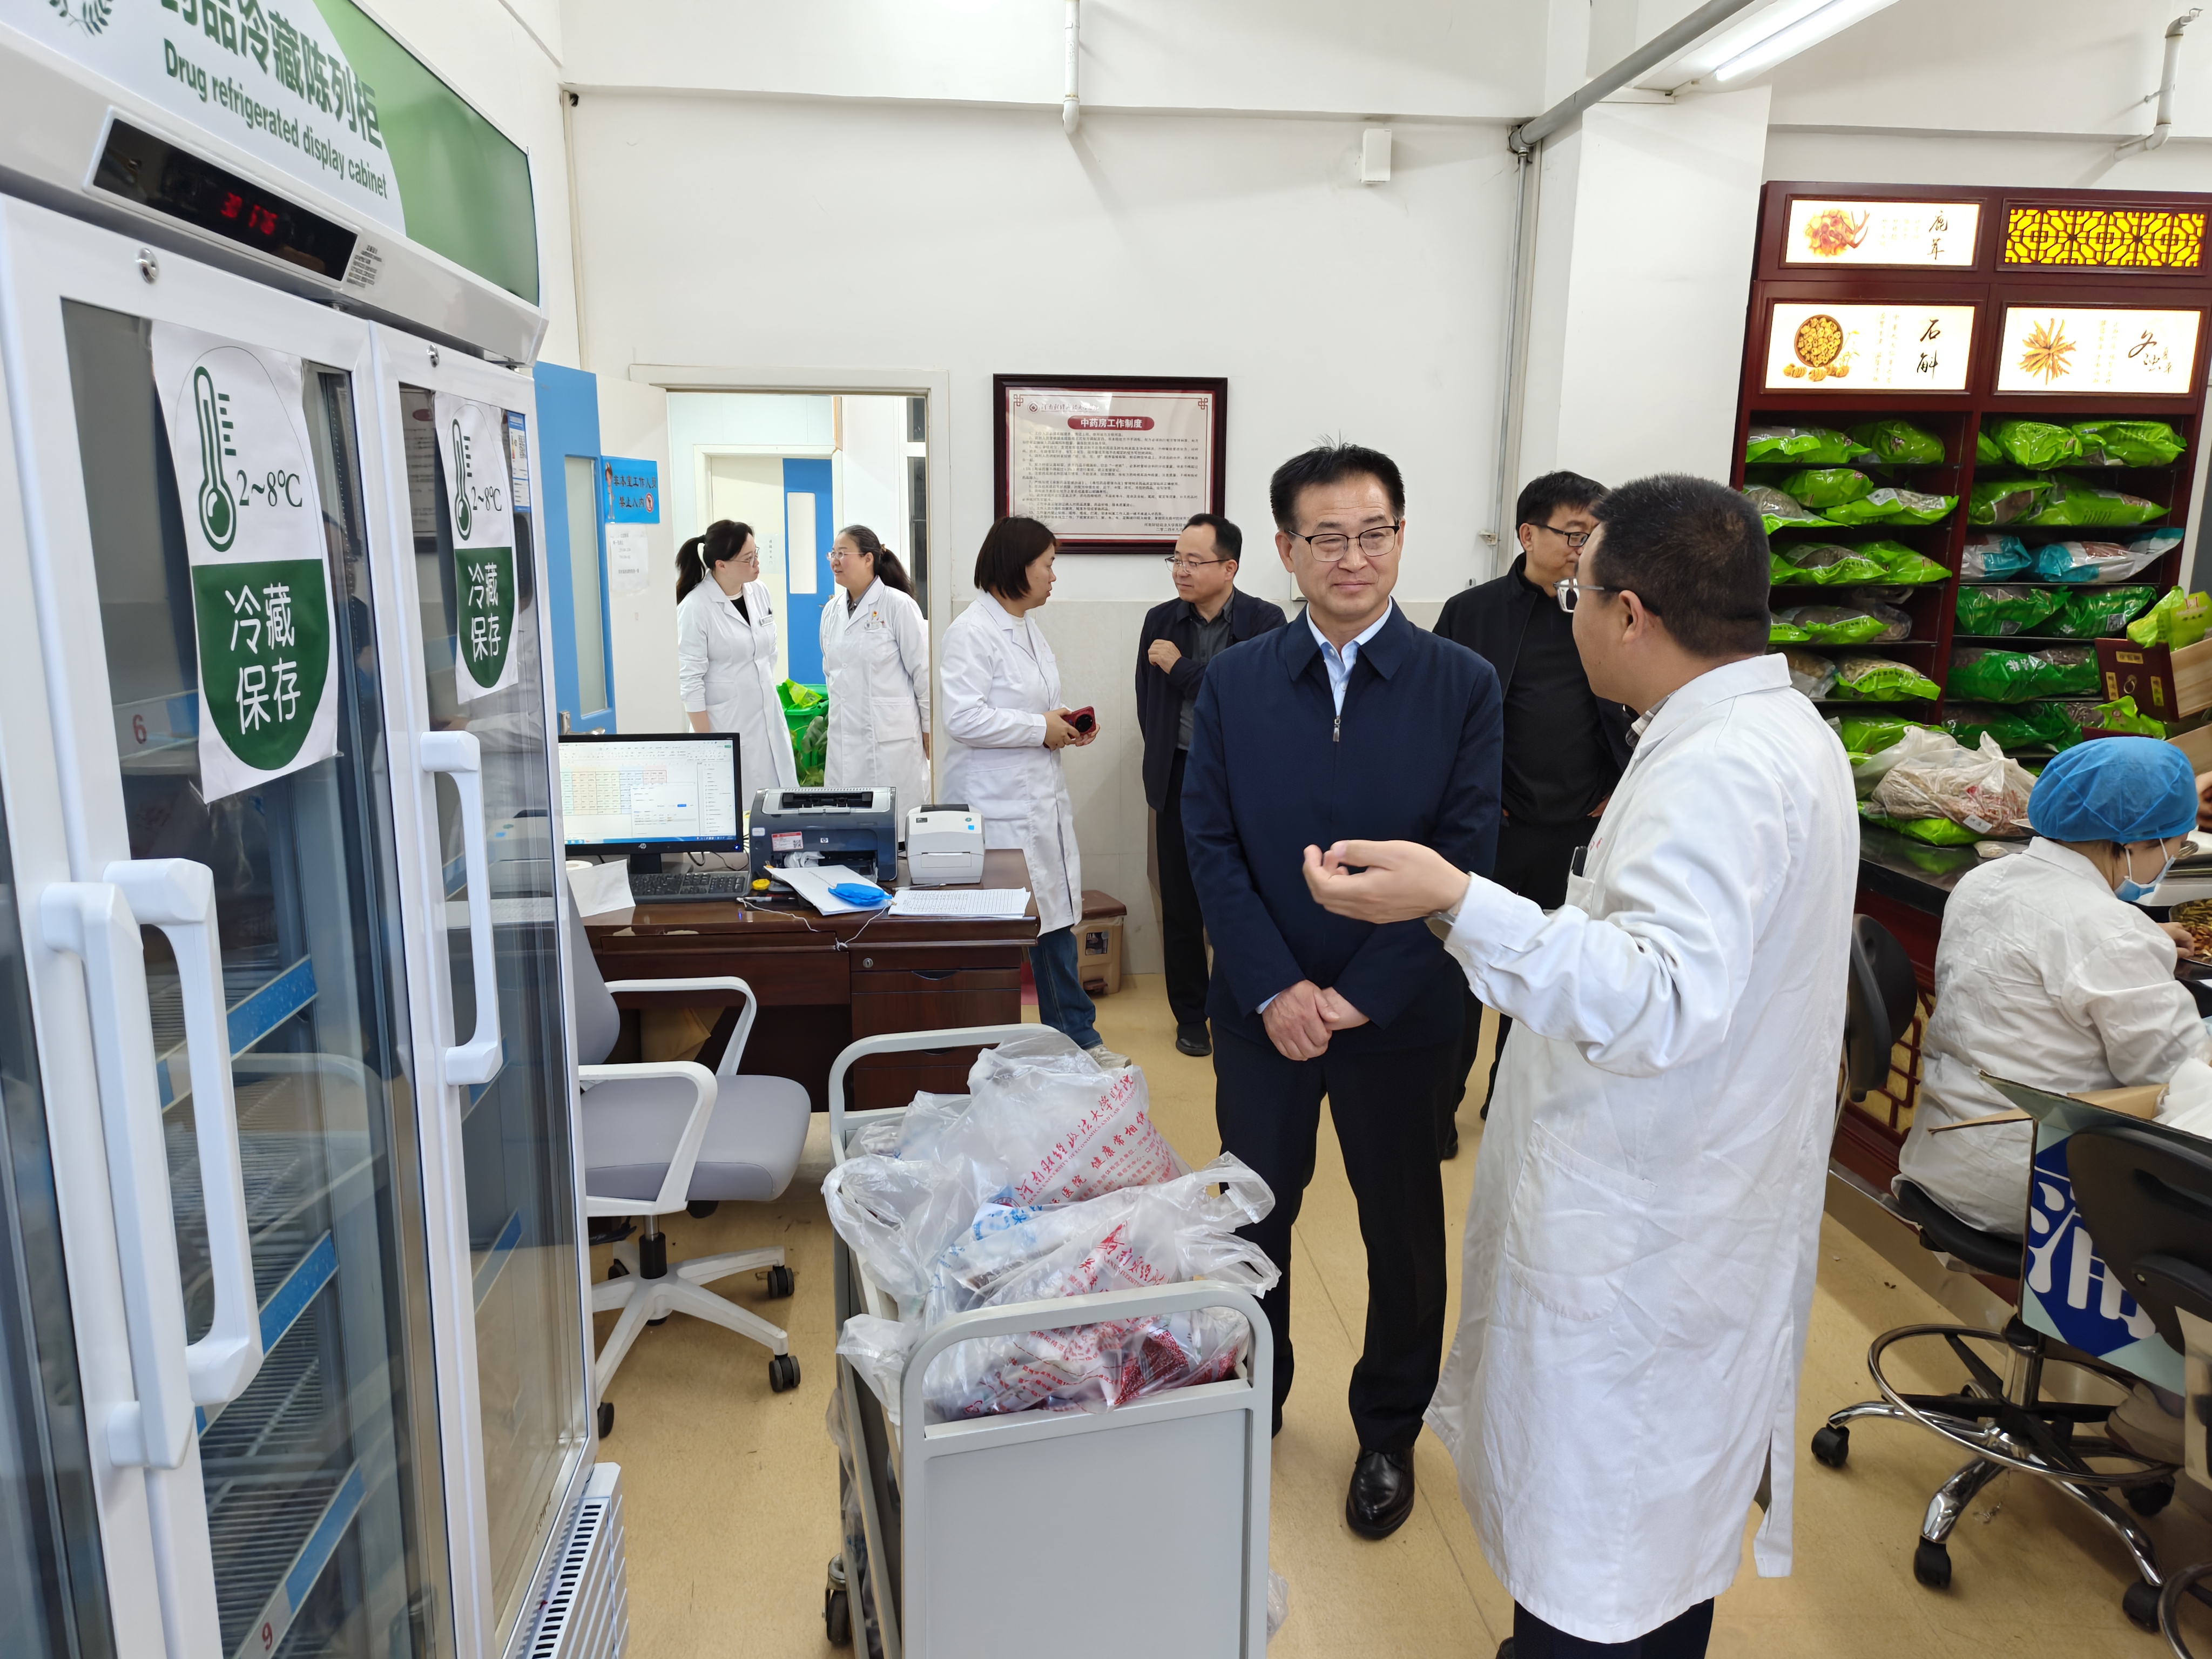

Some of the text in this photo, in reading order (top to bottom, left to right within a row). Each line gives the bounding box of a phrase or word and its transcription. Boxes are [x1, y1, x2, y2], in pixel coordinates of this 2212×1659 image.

[164, 38, 388, 200] Drug refrigerated display cabinet
[1080, 417, 1143, 429] 中药房工作制度
[613, 474, 656, 489] 非本室工作人员
[619, 495, 644, 508] 禁止入内
[468, 562, 498, 610] 冷藏
[225, 582, 294, 655] 冷藏
[471, 612, 501, 663] 保存
[236, 657, 301, 735] 保存
[132, 714, 147, 744] 6
[1042, 1159, 1069, 1189] UNIVERSITY
[1074, 1124, 1101, 1154] ECONOMICS
[262, 1622, 273, 1652] 9
